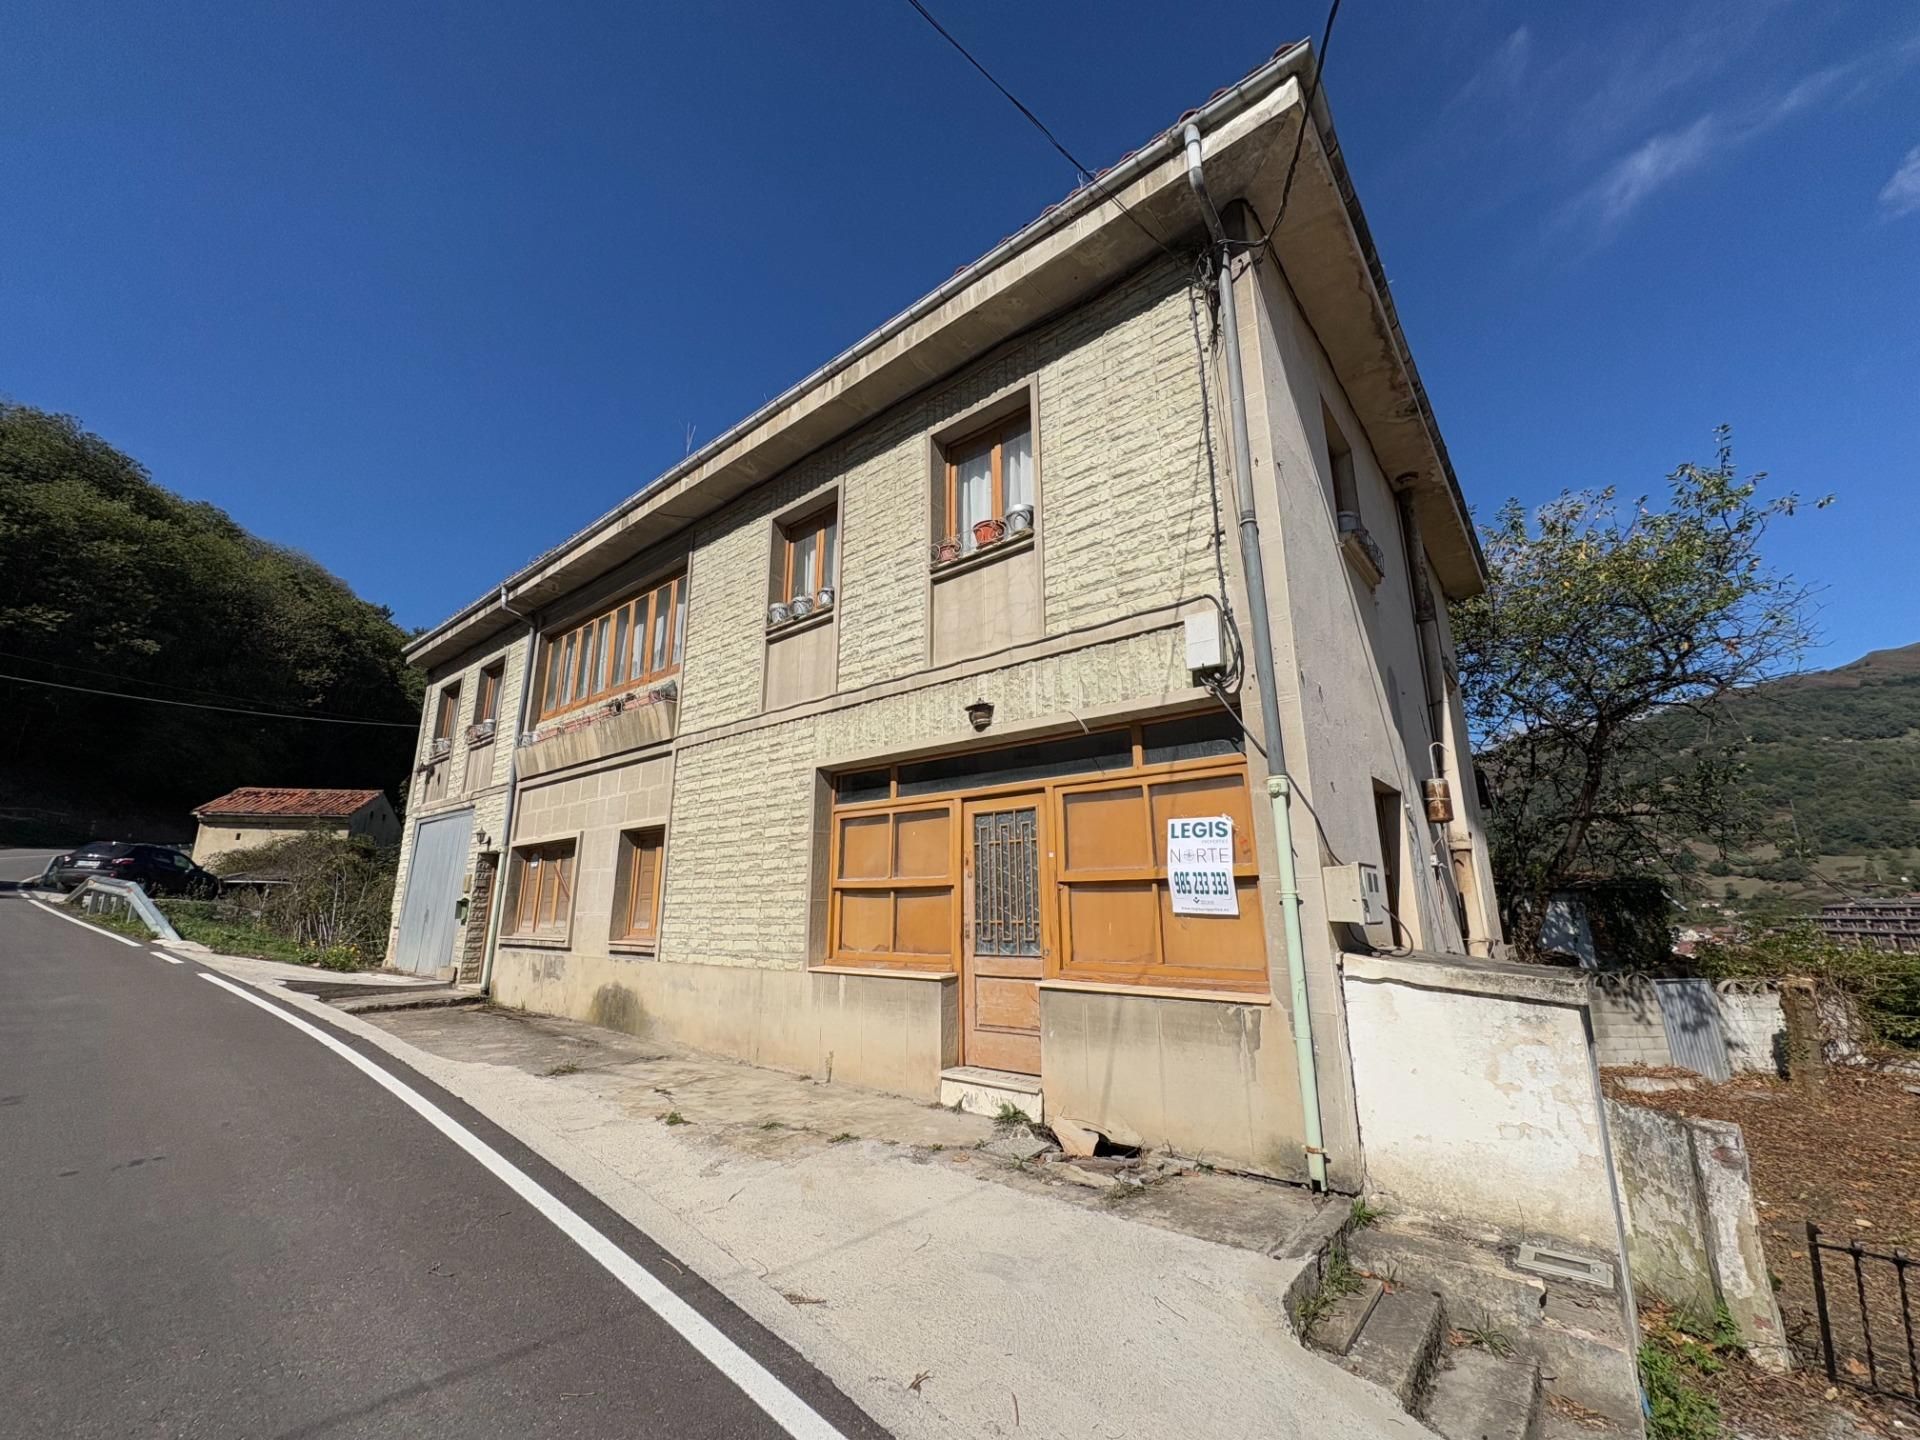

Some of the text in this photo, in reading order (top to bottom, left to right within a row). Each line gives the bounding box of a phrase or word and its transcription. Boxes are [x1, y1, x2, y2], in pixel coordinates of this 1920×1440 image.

[1171, 821, 1228, 839] LEGIS
[1173, 871, 1230, 895] 985 233 333
